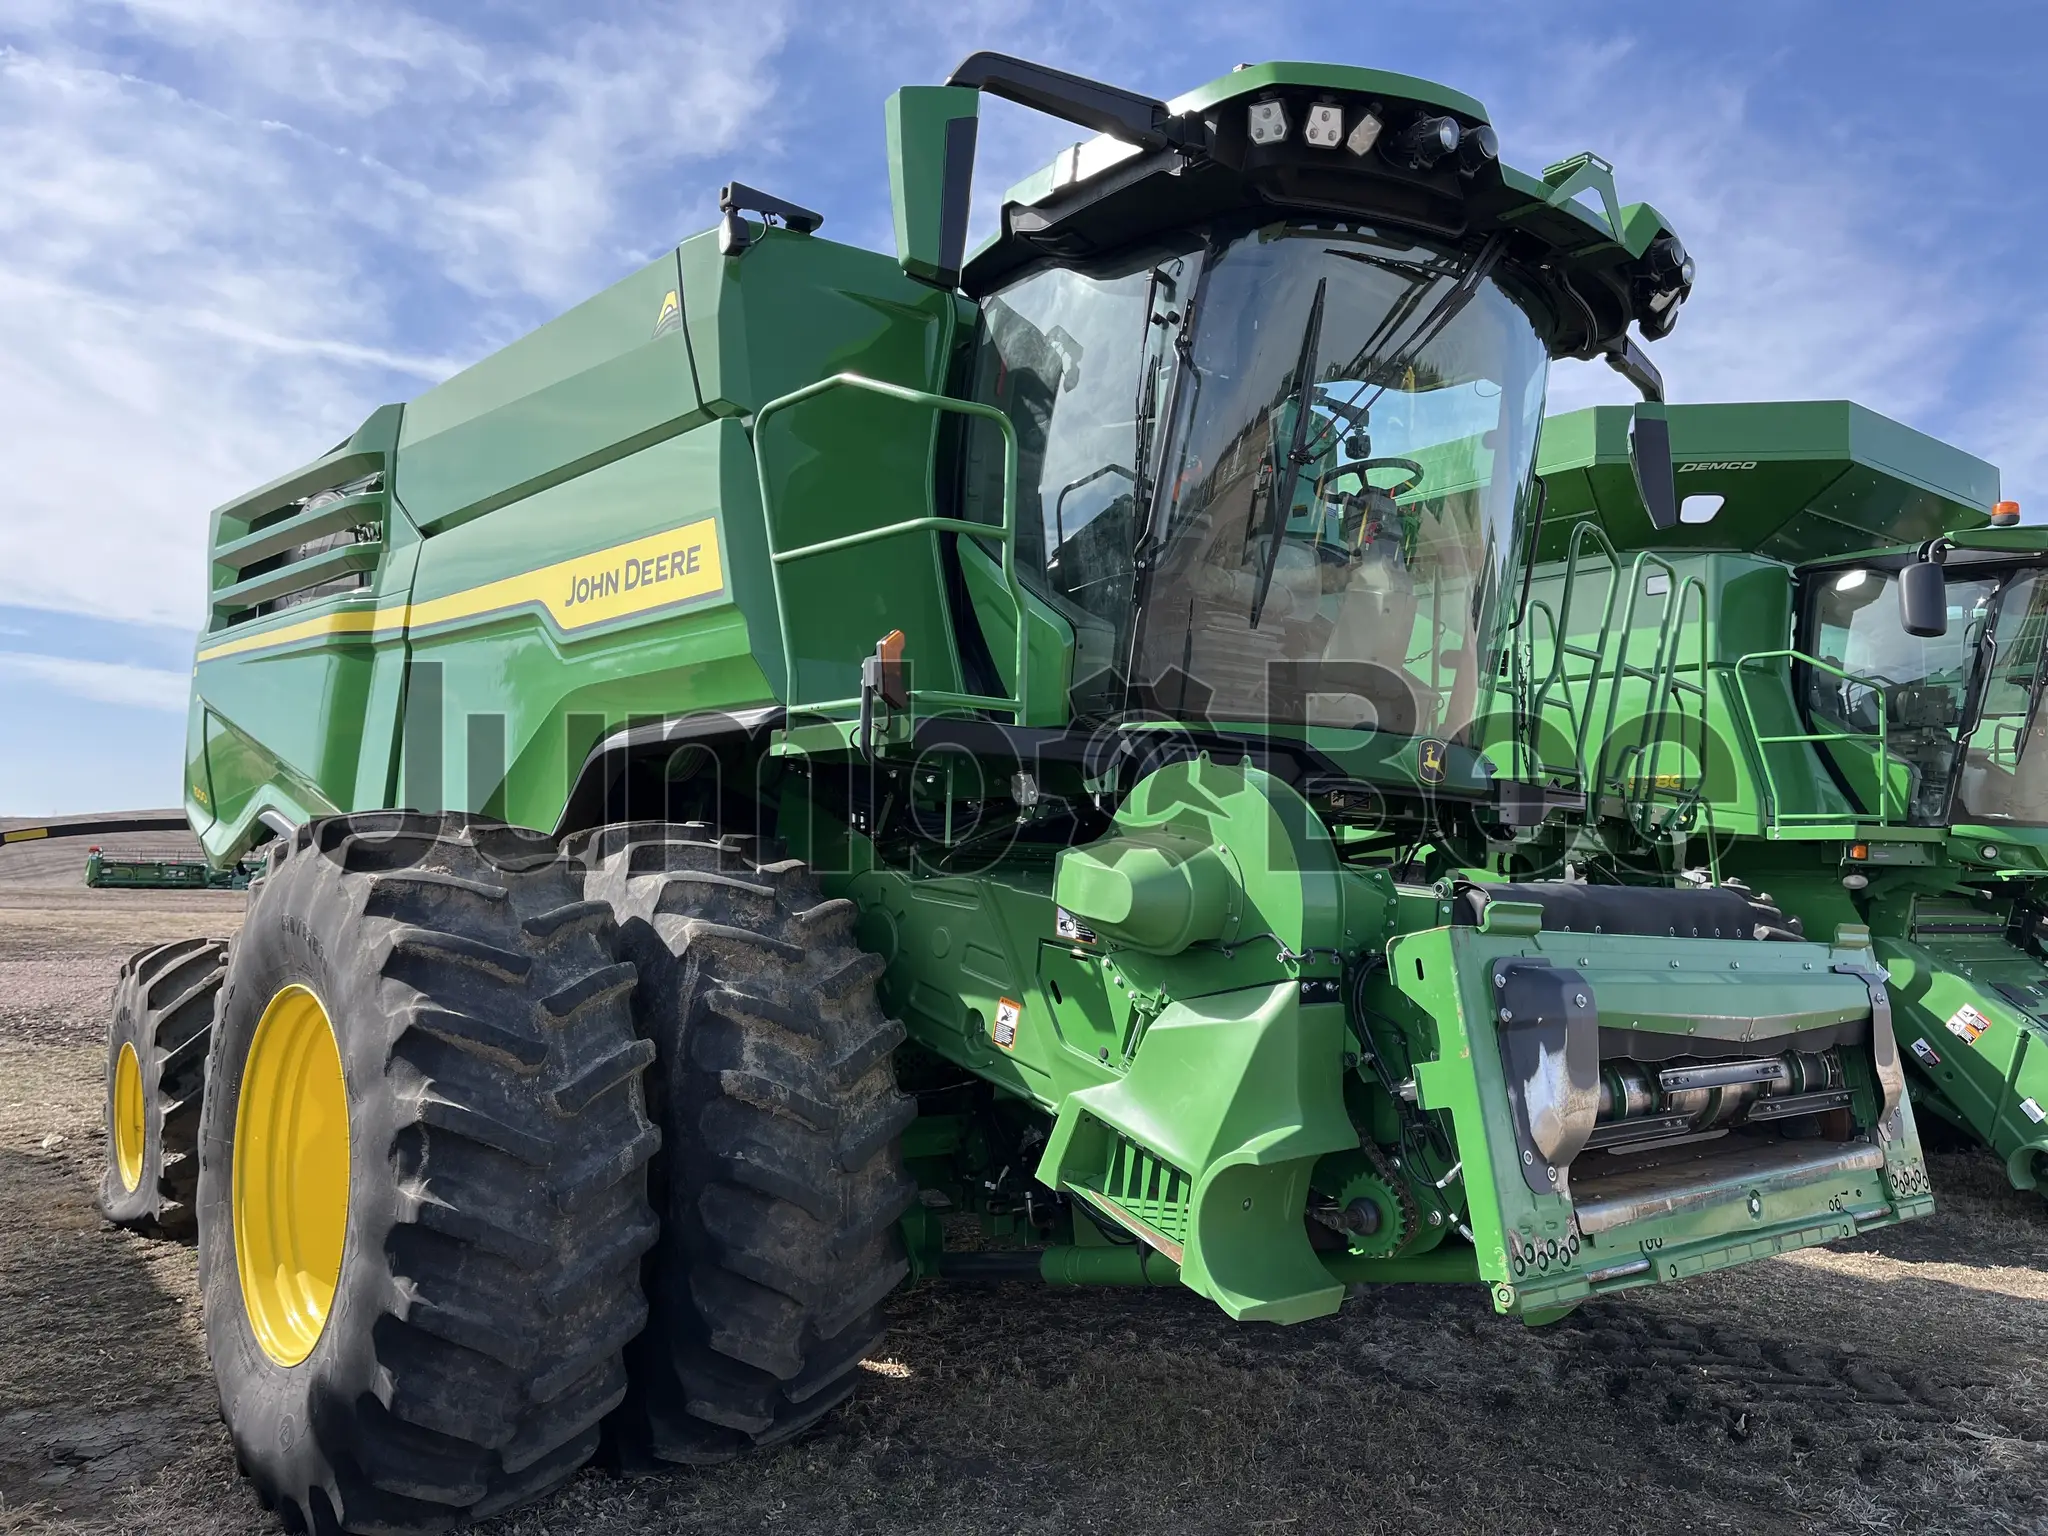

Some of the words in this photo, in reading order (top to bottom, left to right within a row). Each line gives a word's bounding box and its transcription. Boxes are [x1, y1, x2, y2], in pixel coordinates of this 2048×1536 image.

[1677, 461, 1758, 473] DEMCO
[565, 568, 619, 607] JOHN
[624, 544, 701, 592] DEERE
